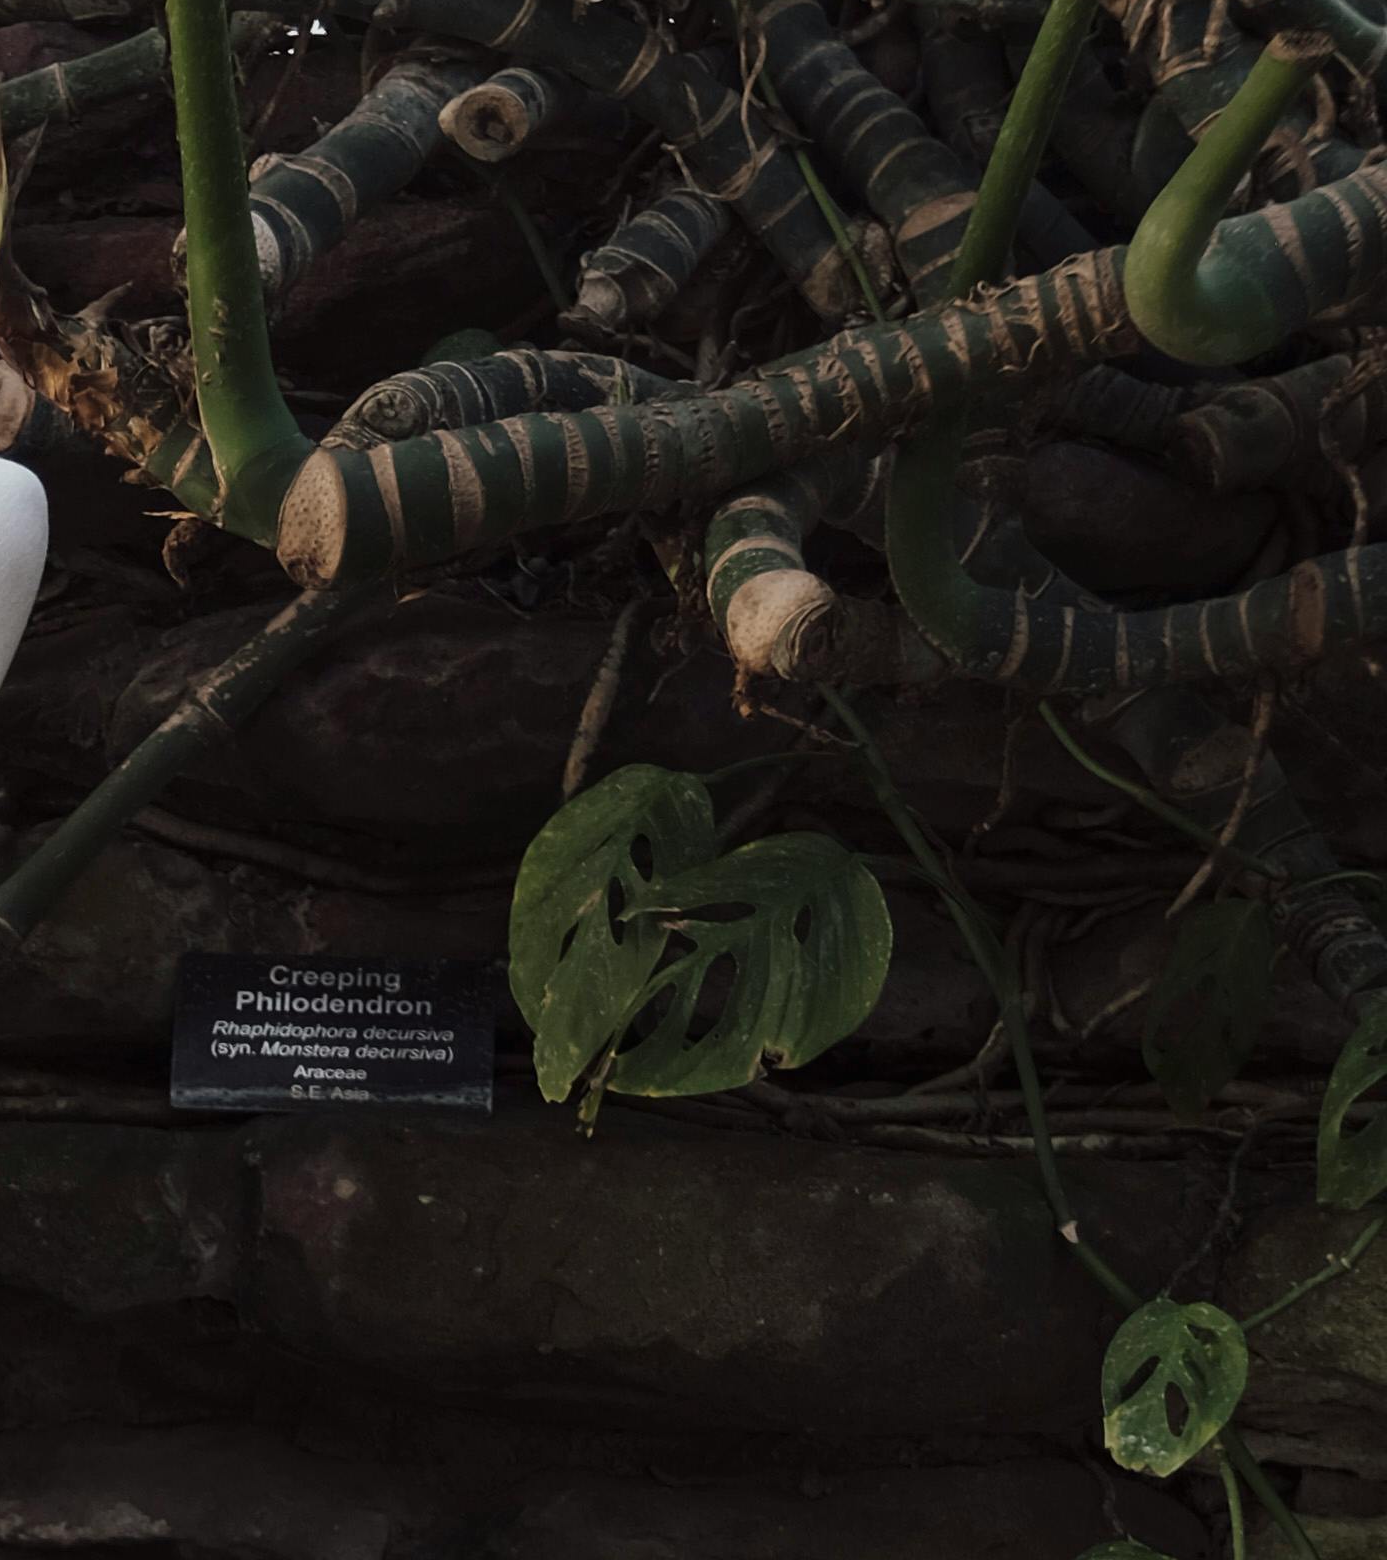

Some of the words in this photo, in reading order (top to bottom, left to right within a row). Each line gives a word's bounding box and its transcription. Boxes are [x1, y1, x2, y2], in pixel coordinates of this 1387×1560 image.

[269, 965, 401, 993] Creeping
[235, 991, 432, 1016] Philodendron
[212, 1020, 357, 1040] Rhaphidophora
[363, 1025, 454, 1041] decursiva
[210, 1040, 256, 1058] (syn.
[260, 1041, 349, 1058] Monstera
[355, 1045, 454, 1062] decursiva)
[293, 1065, 367, 1080] Araceae
[331, 1086, 370, 1101] Asia
